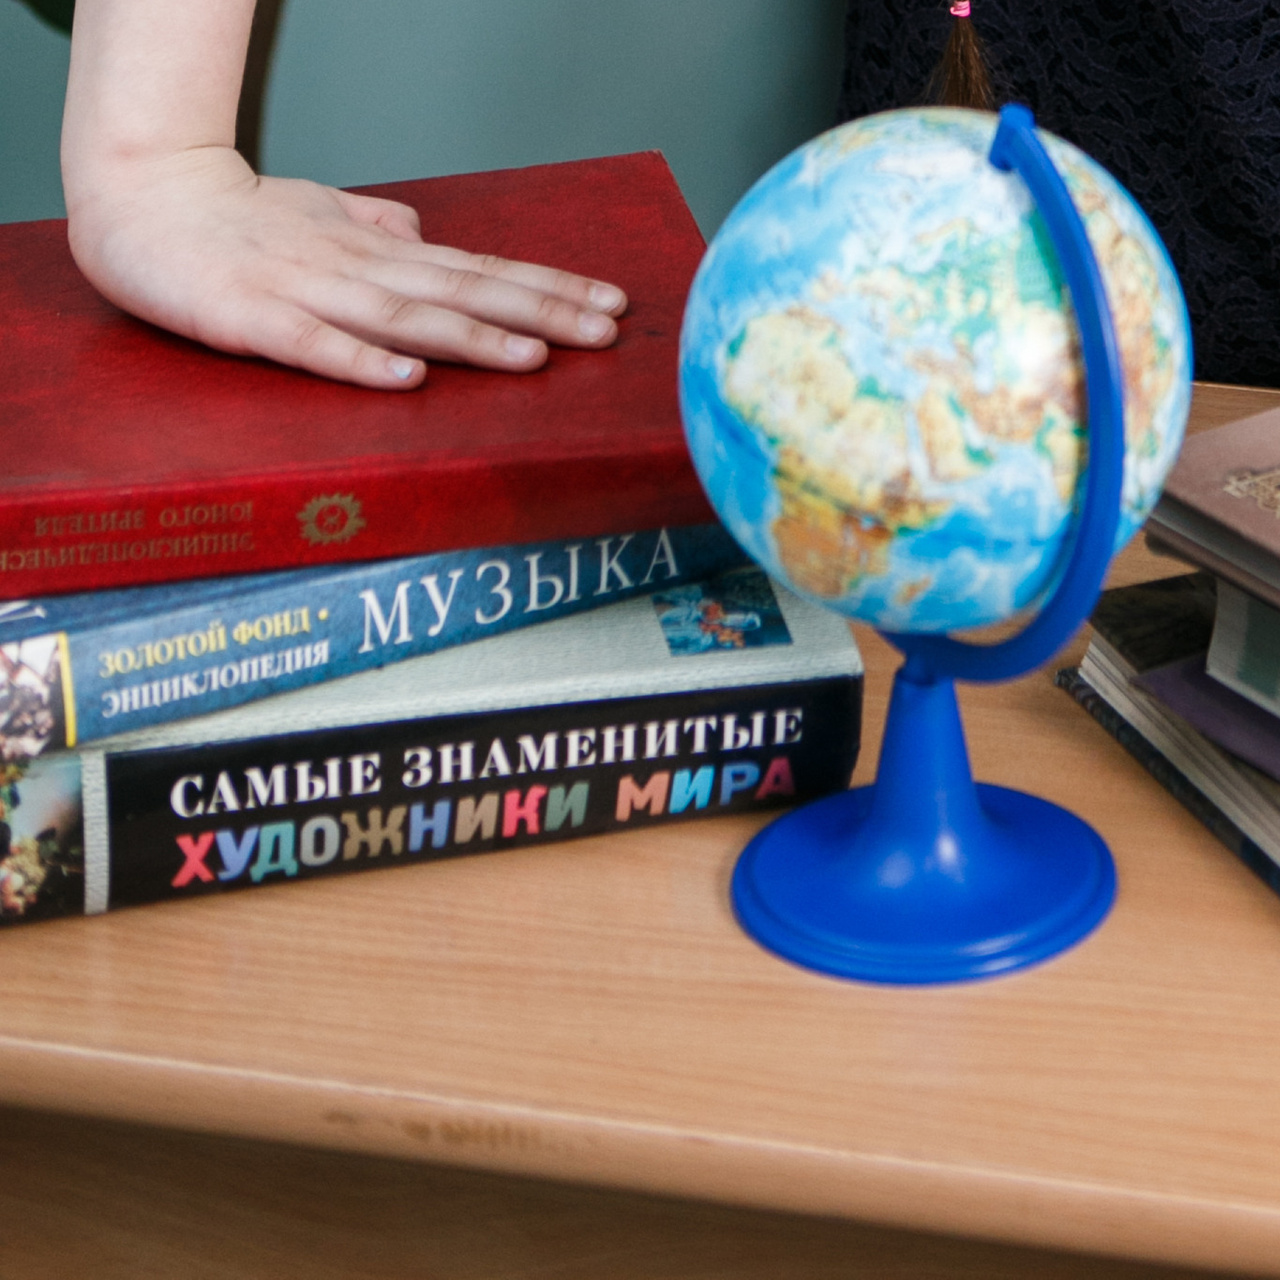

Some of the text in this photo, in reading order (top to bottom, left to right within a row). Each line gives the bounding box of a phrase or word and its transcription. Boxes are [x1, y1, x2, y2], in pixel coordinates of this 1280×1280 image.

[35, 501, 254, 537] ЮНОГО ЗРИТЕЛЯ
[358, 527, 680, 654] МУЗЫКА
[99, 606, 311, 679] ЗОЛОТОЙ ФОНД
[101, 639, 330, 719] ЭНЦИКЛОПЕДИЯ
[169, 707, 803, 818] САМЫЕ ЗНАМЕНИТЫЕ
[170, 755, 796, 888] ХУДОЖНИКИ МИРА
